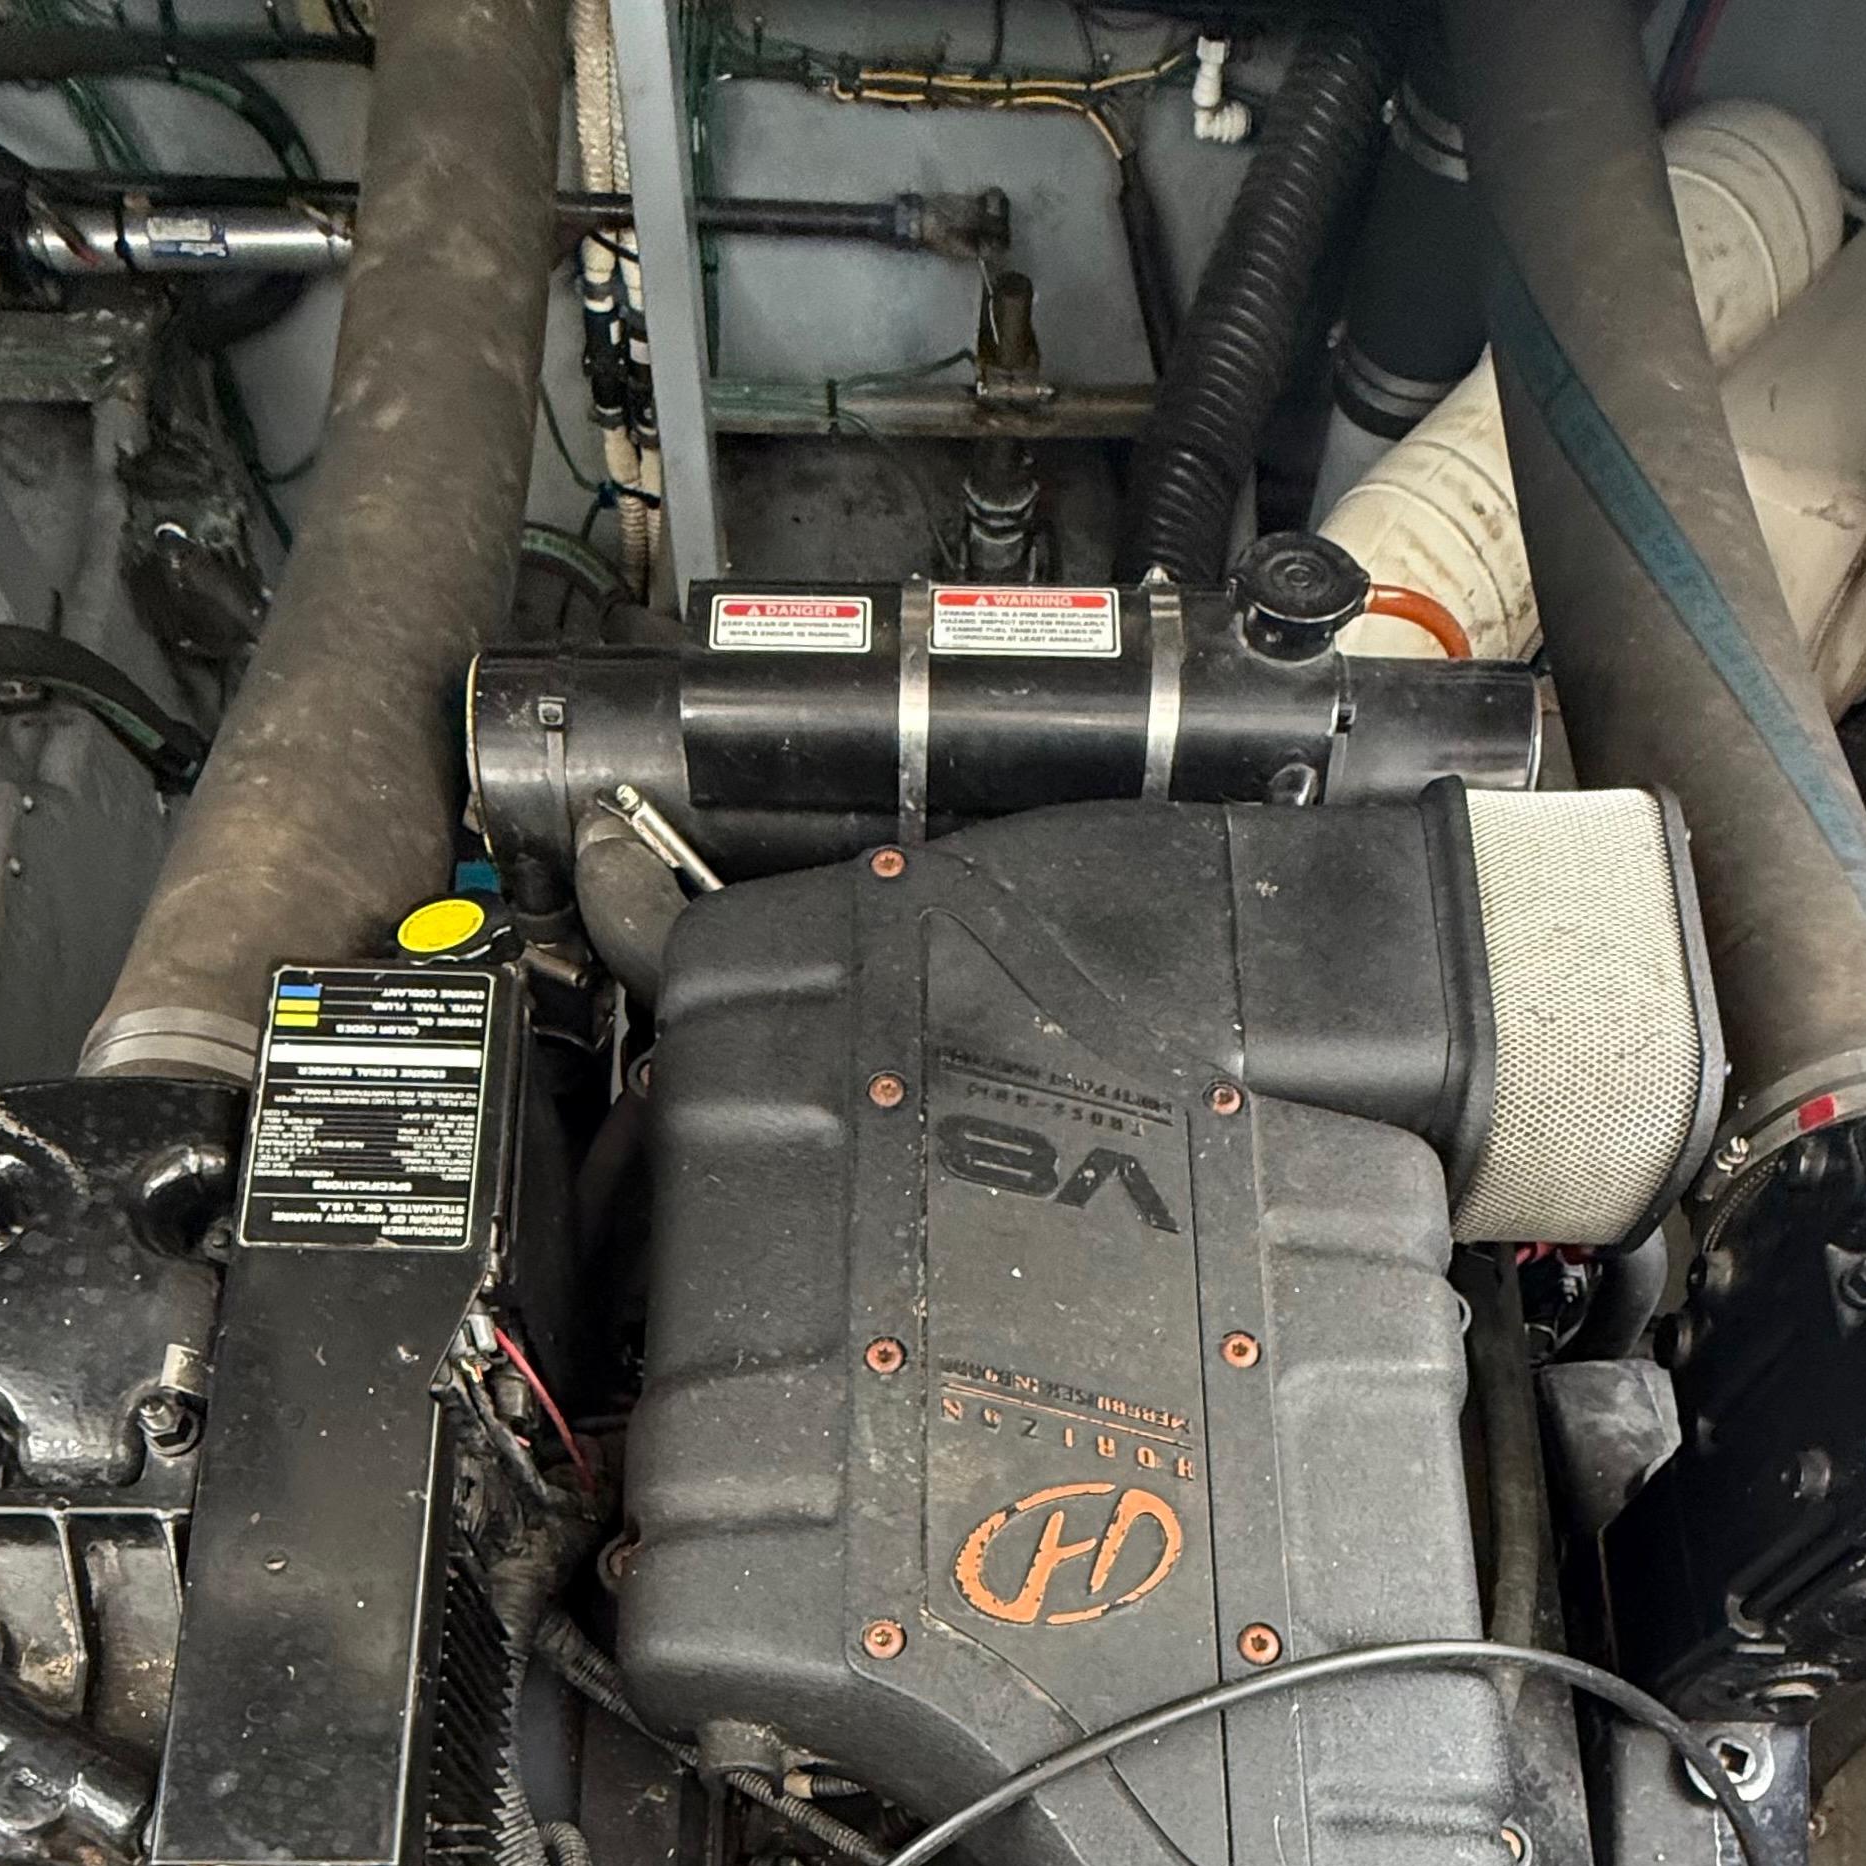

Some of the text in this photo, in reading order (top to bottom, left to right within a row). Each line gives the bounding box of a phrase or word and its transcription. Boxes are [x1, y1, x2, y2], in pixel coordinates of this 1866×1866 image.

[993, 596, 1072, 607] WARNING
[766, 606, 837, 616] DANGER
[381, 988, 485, 999] ENGINE COOLANT
[437, 1018, 482, 1027] ENGINE
[335, 1024, 419, 1035] COLOR CODES
[297, 1067, 446, 1078] ENGINE SERIAL NUMBER
[333, 1089, 394, 1097] MAINTENANCE
[417, 1091, 464, 1099] OPERATION
[304, 1096, 369, 1104] REQUIREMENTS
[459, 1099, 477, 1107] FOR
[445, 1143, 472, 1151] SPARK
[441, 1173, 469, 1181] MODEL
[933, 1112, 1181, 1234] V8
[312, 1180, 412, 1191] SPECIFICATIONS
[316, 1202, 354, 1212] U.S.A.
[386, 1203, 465, 1213] STILLWATER,
[271, 1211, 464, 1224] DIVISION OF MERCURY MARINE
[381, 1226, 463, 1236] MERCRUISER
[940, 1396, 1194, 1481] HORIZON
